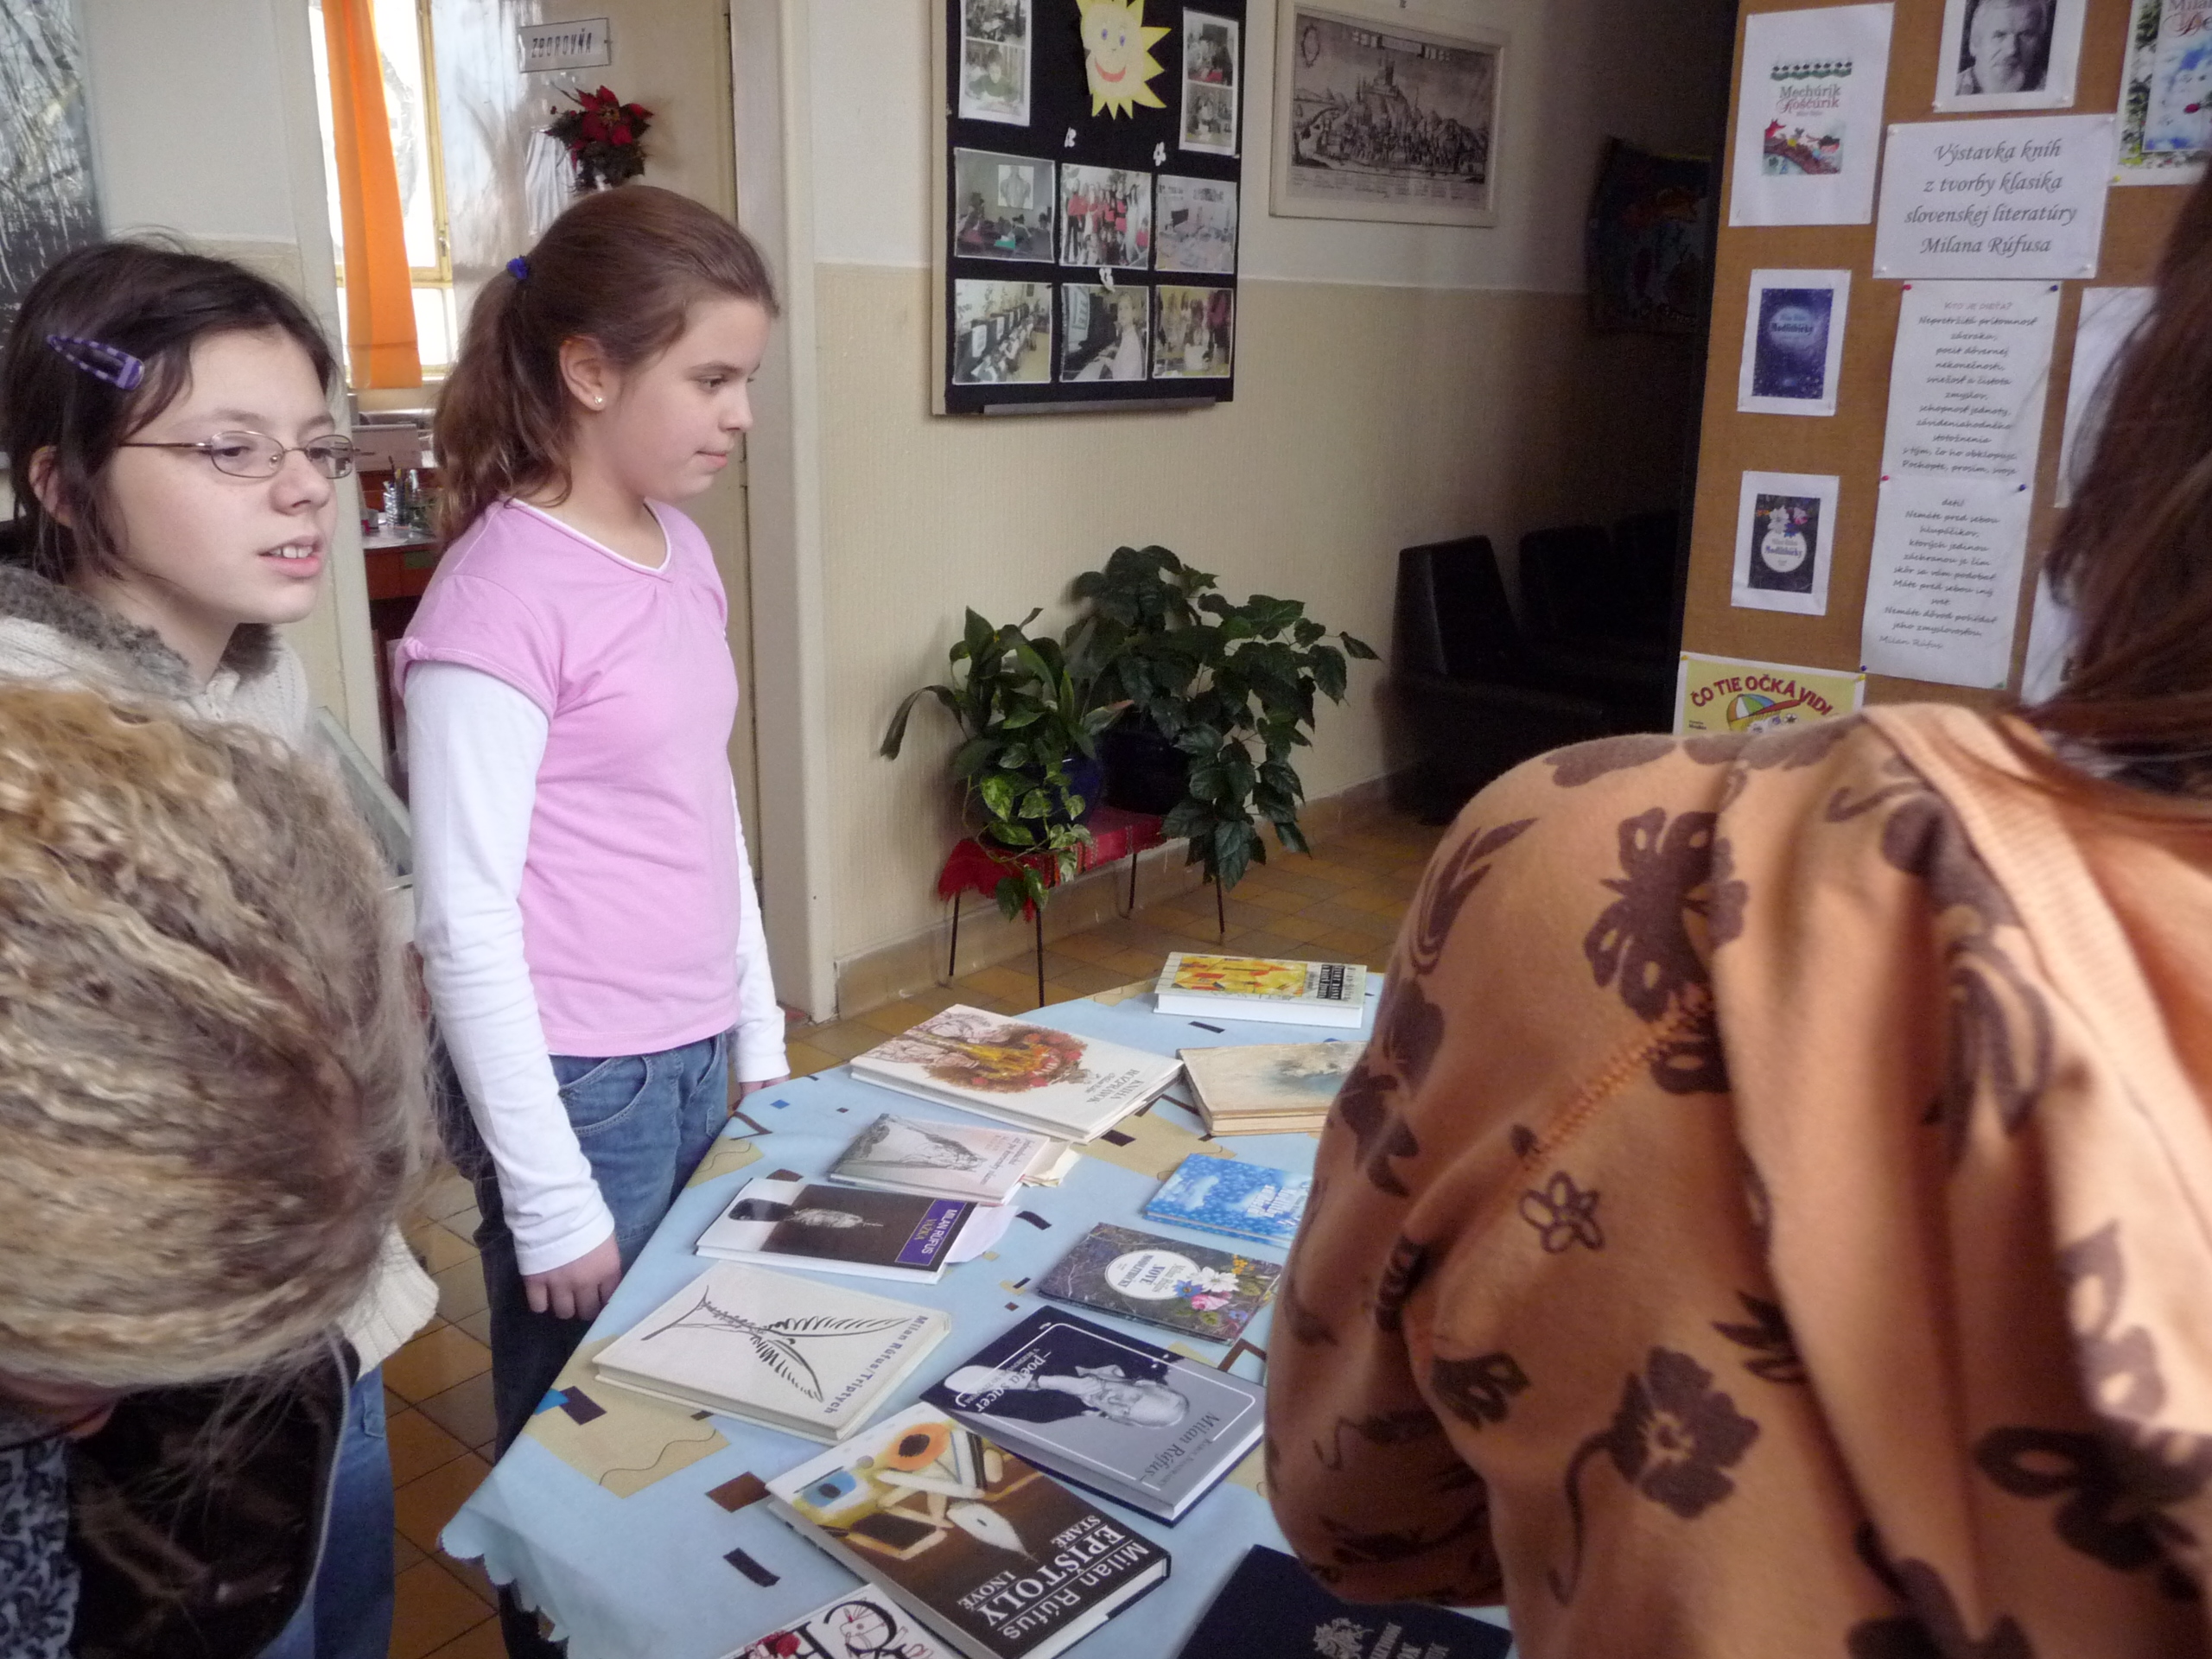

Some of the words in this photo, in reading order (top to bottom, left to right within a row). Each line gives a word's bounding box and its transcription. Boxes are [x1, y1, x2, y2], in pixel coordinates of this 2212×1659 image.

[531, 28, 592, 58] ZBOROVŇA
[1934, 141, 2017, 167] Výstavka
[2020, 138, 2063, 162] kníh
[1923, 180, 1935, 193] z
[1939, 173, 1995, 197] tvorby
[1999, 170, 2063, 194] klasika
[1904, 204, 1988, 227] slovenskej
[1992, 203, 2077, 226] literatúry
[1920, 235, 1983, 254] Milana
[1988, 234, 2052, 257] Rúfusa
[1690, 687, 1714, 708] ČO
[1713, 677, 1742, 696] TIE
[1110, 1079, 1144, 1099] KNIHA
[937, 1209, 957, 1230] MILAN
[921, 1230, 945, 1255] RÚFUS
[898, 1315, 929, 1340] Milan
[976, 1382, 1010, 1413] sacer
[1179, 1412, 1220, 1444] Milan
[1051, 1515, 1101, 1548] STARÉ
[977, 1524, 1126, 1626] EPIŠTOLY
[1079, 1541, 1150, 1586] Milan
[957, 1574, 1007, 1611] NOVÉ
[1002, 1588, 1082, 1640] Rúfus
